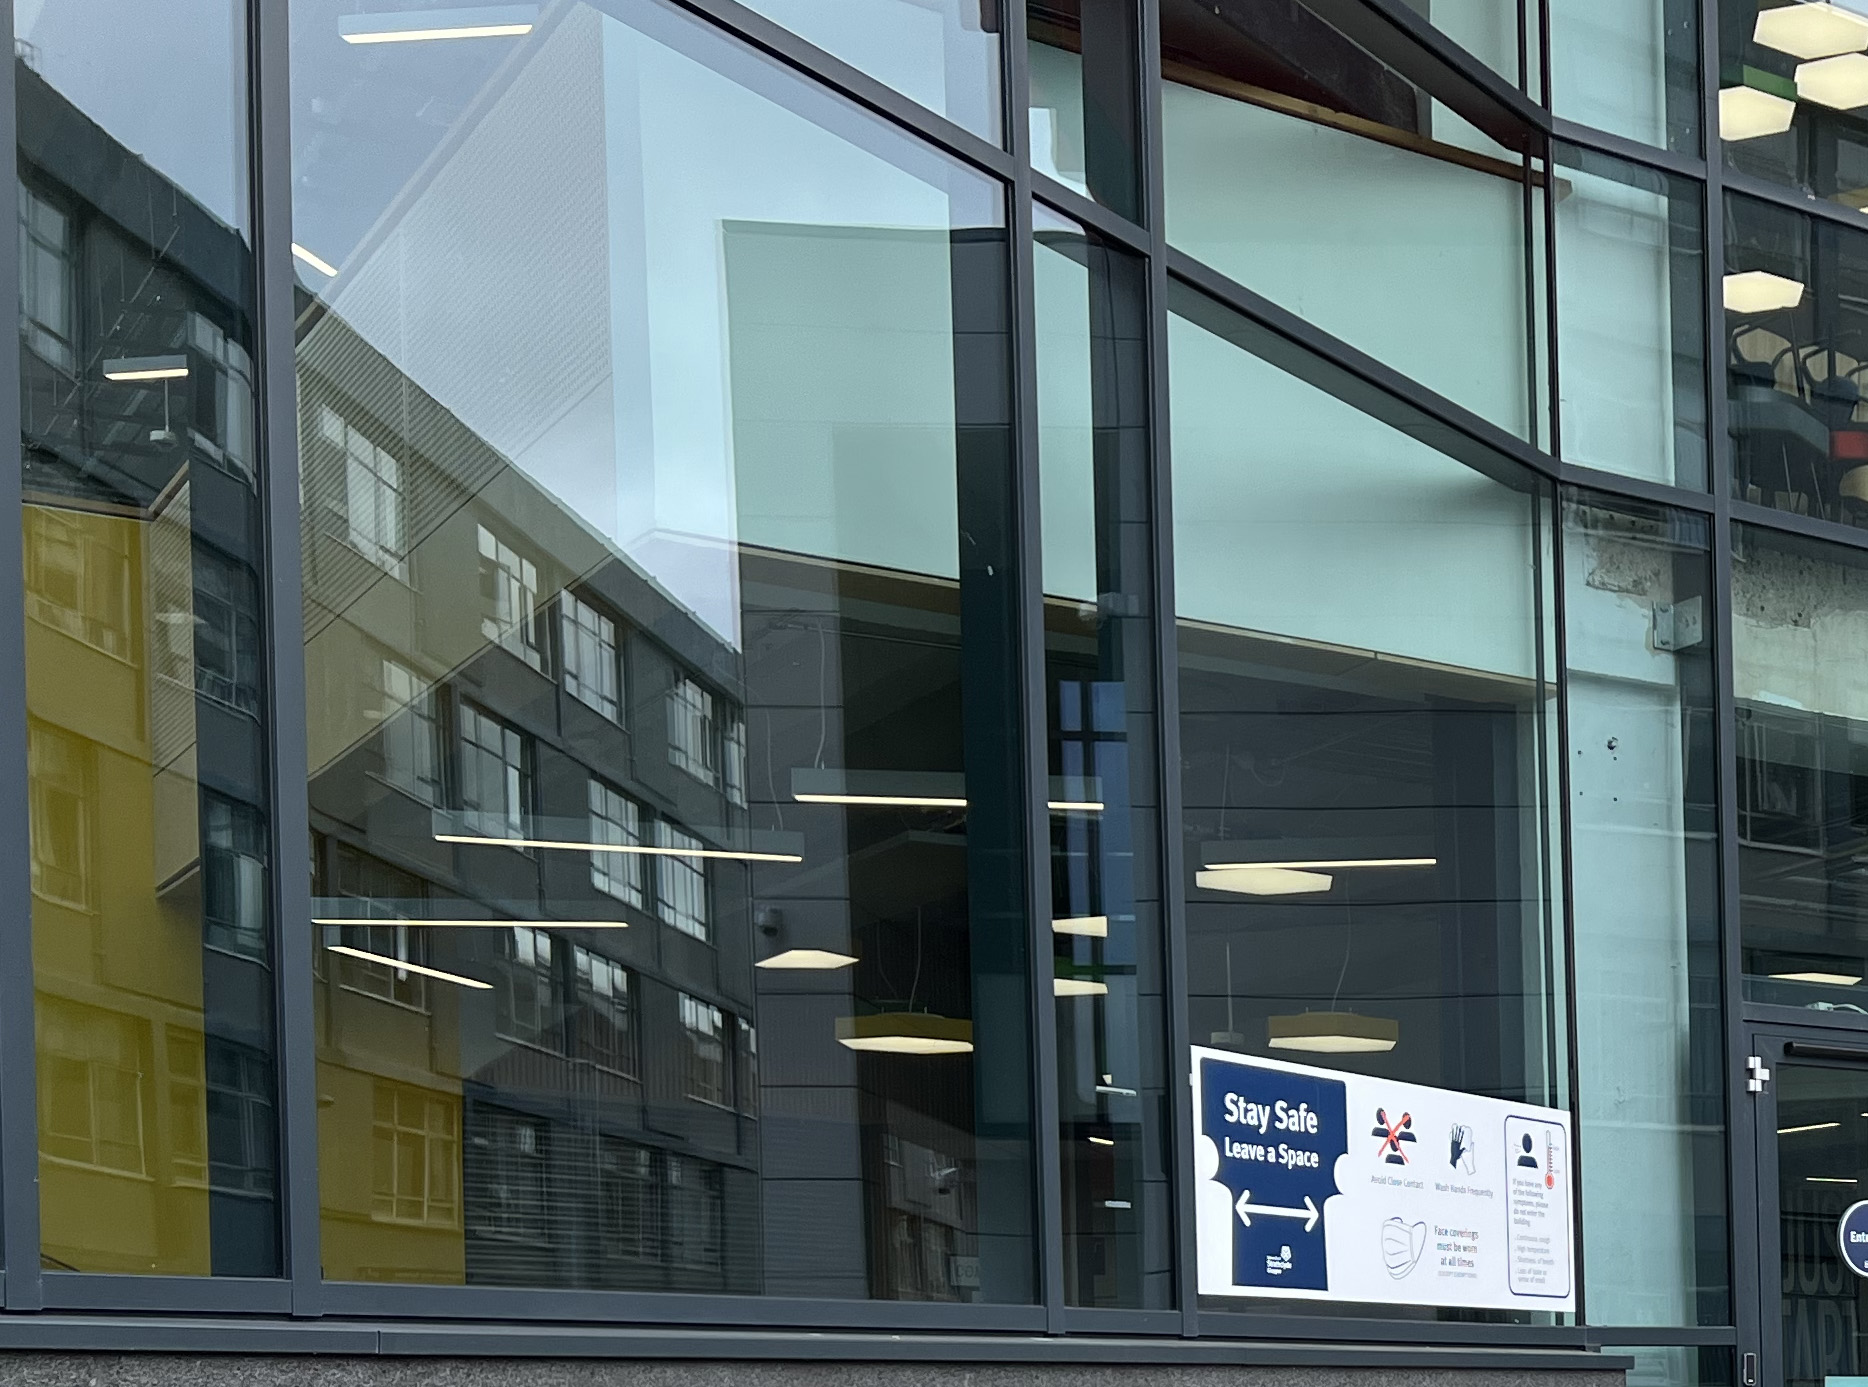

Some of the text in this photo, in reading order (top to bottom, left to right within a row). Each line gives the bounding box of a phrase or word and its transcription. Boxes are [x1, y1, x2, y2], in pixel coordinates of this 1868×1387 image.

[1223, 1092, 1318, 1134] Stay Safe
[1224, 1136, 1319, 1170] Leave a Space
[1434, 1224, 1449, 1237] Face
[1453, 1241, 1462, 1253] be
[1440, 1256, 1447, 1266] at
